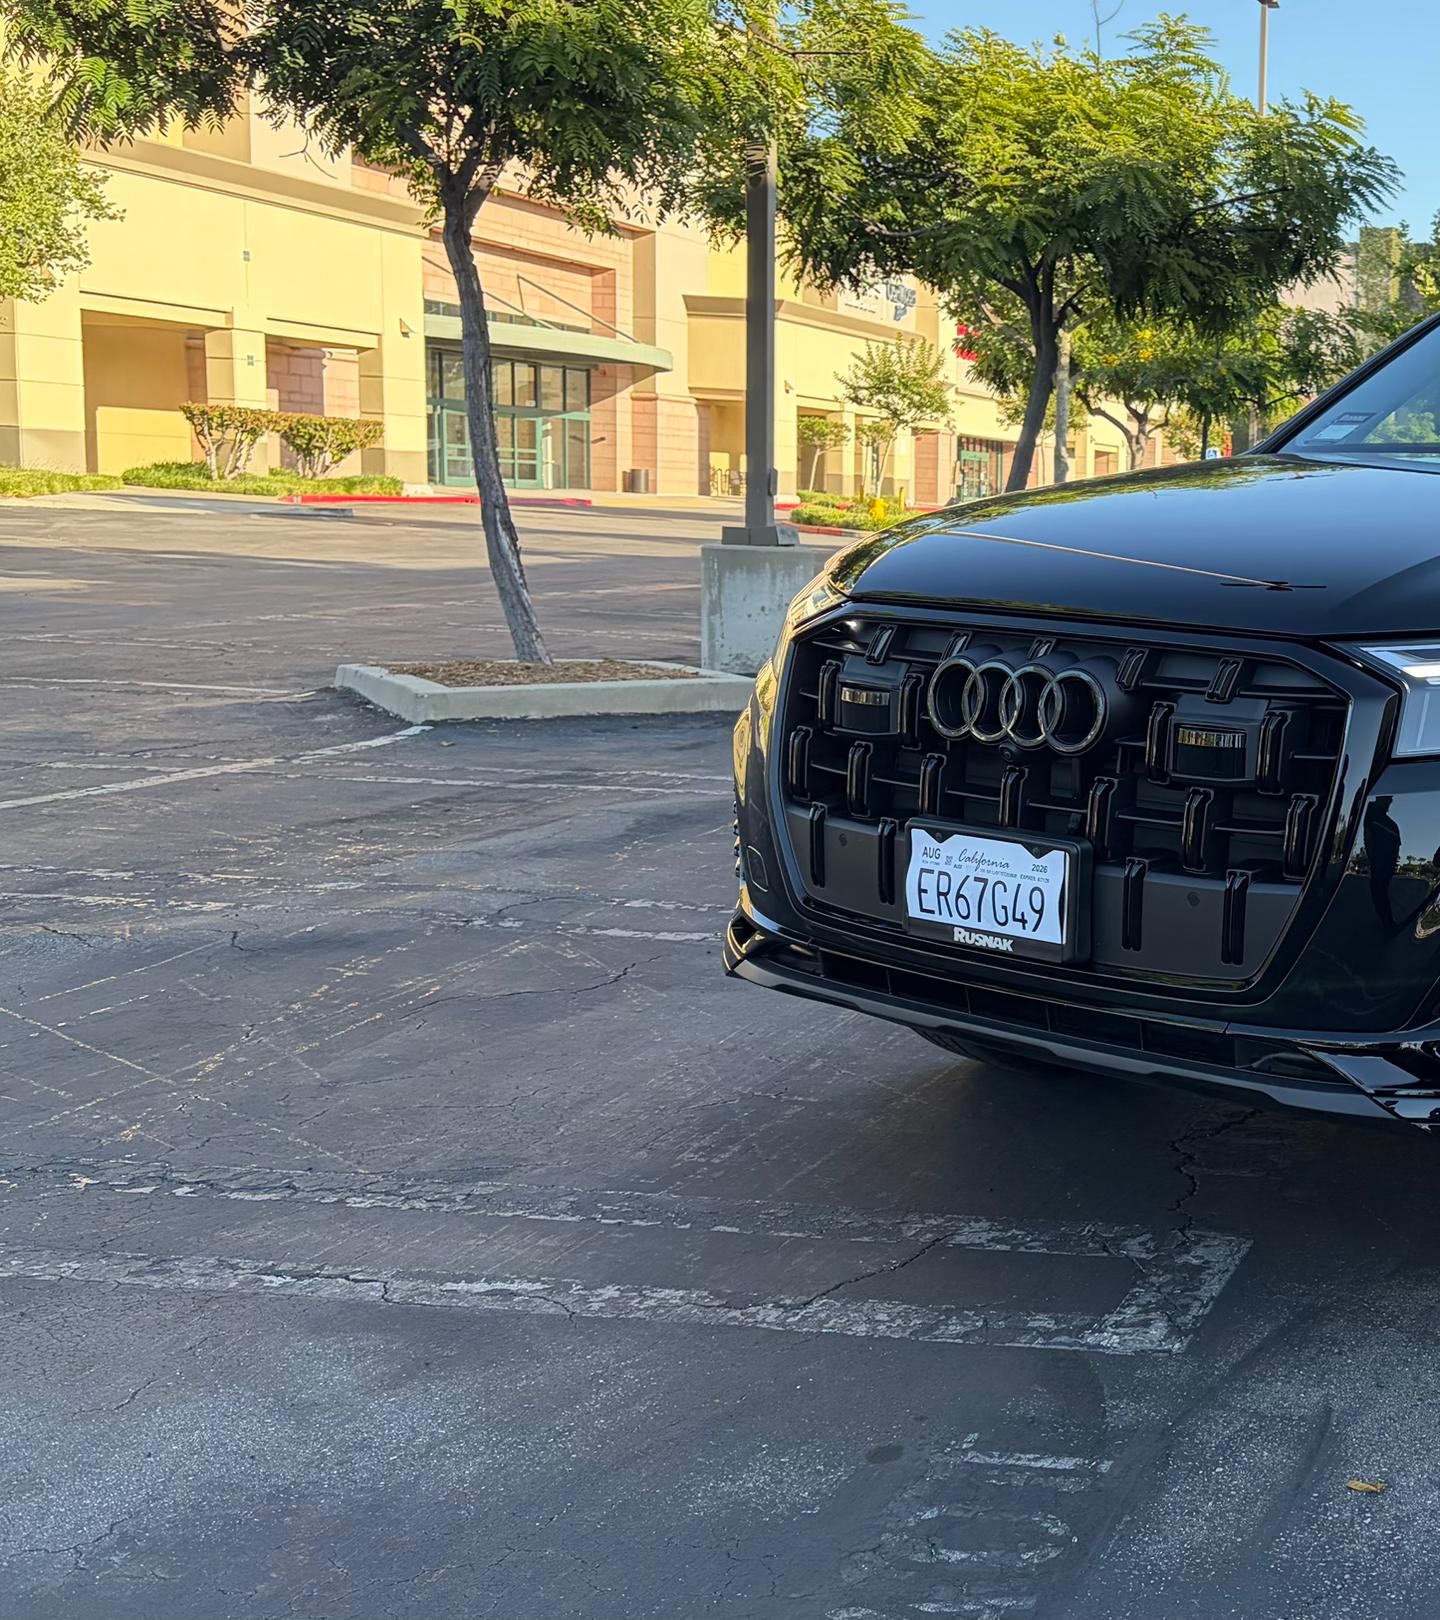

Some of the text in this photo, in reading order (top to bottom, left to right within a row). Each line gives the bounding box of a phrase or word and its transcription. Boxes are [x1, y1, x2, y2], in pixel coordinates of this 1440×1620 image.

[922, 846, 941, 860] AUG
[958, 848, 1010, 872] California
[1031, 863, 1048, 874] 2026
[917, 867, 1045, 933] ER67G49
[953, 926, 1014, 952] RUSNAK
